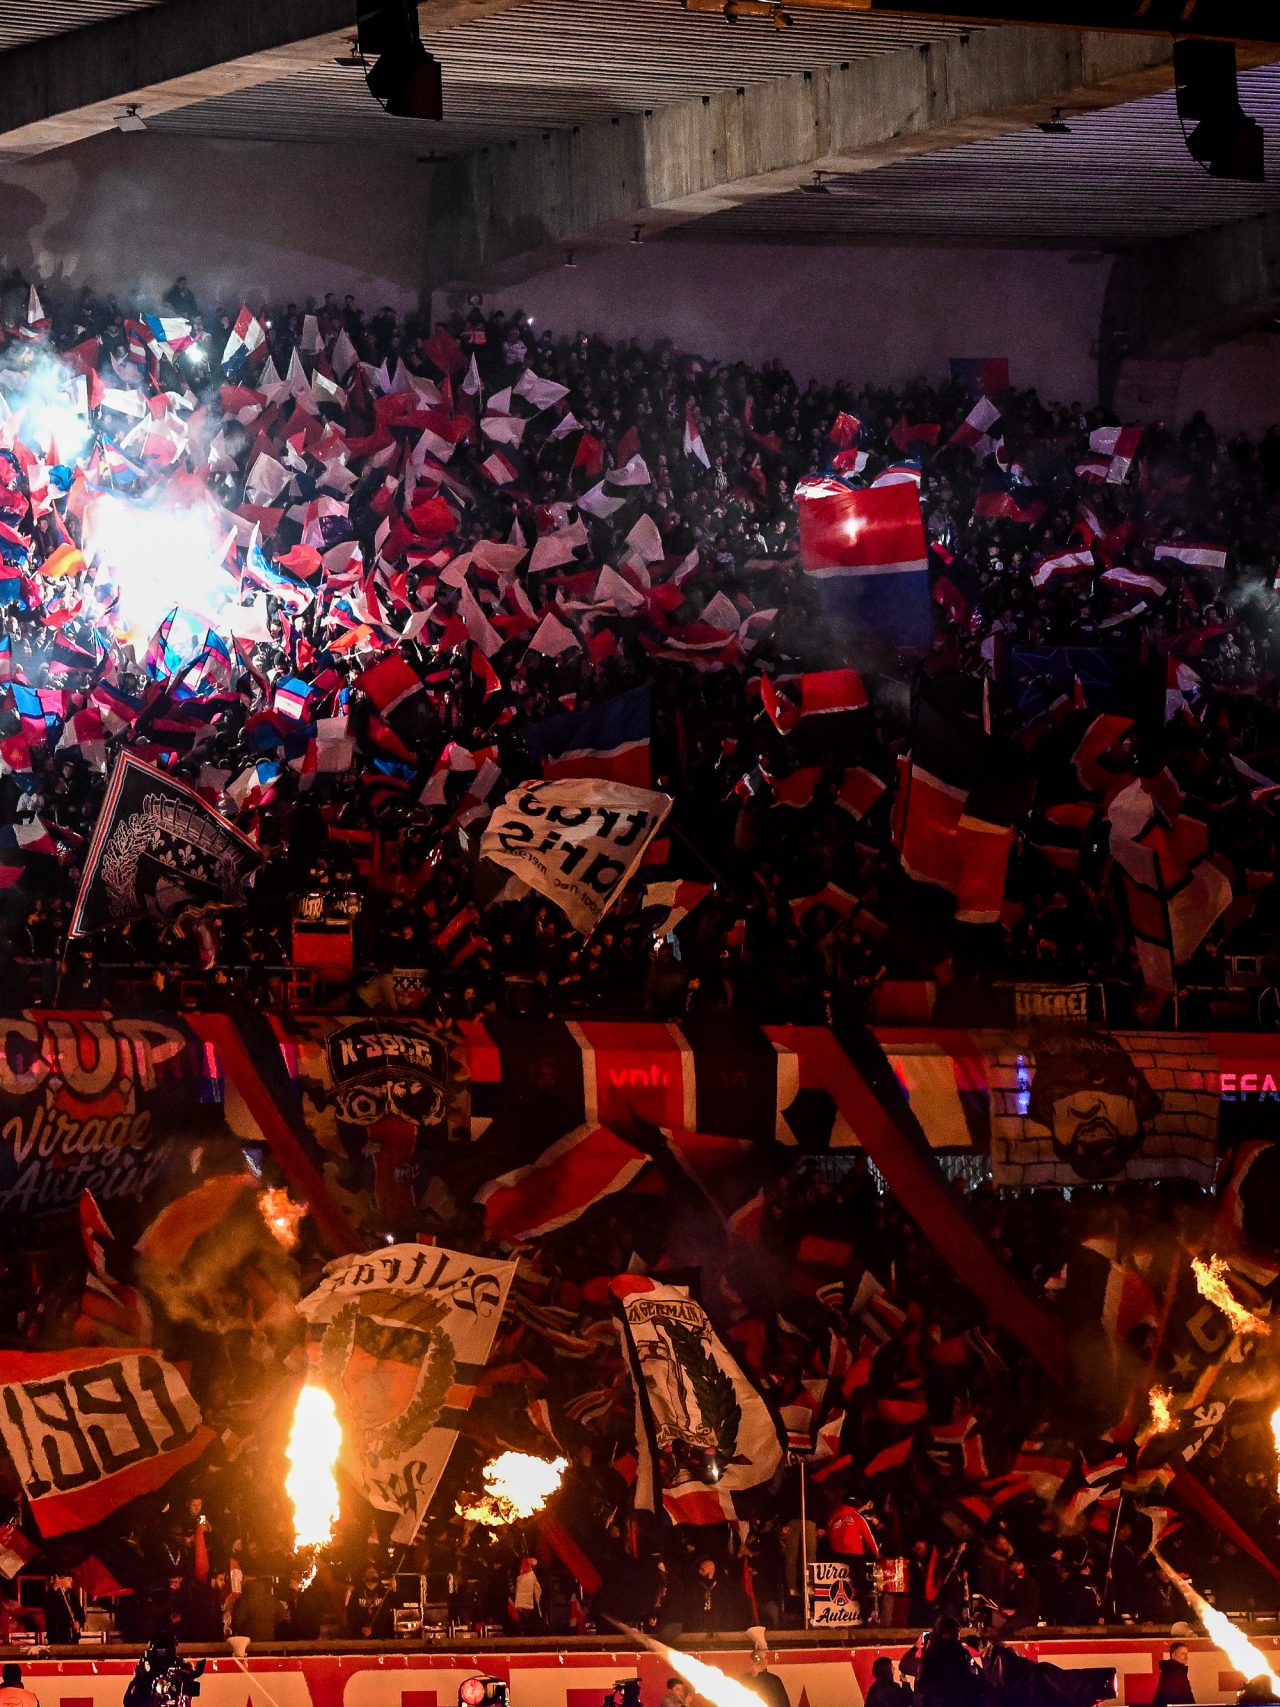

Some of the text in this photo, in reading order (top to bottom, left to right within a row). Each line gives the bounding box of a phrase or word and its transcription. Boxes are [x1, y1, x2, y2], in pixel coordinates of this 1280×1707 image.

[1220, 1073, 1280, 1103] EFA
[1, 1104, 152, 1168] Virage
[2, 1355, 199, 1499] 1991
[816, 1563, 849, 1580] Vira
[816, 1607, 861, 1623] Auteu
